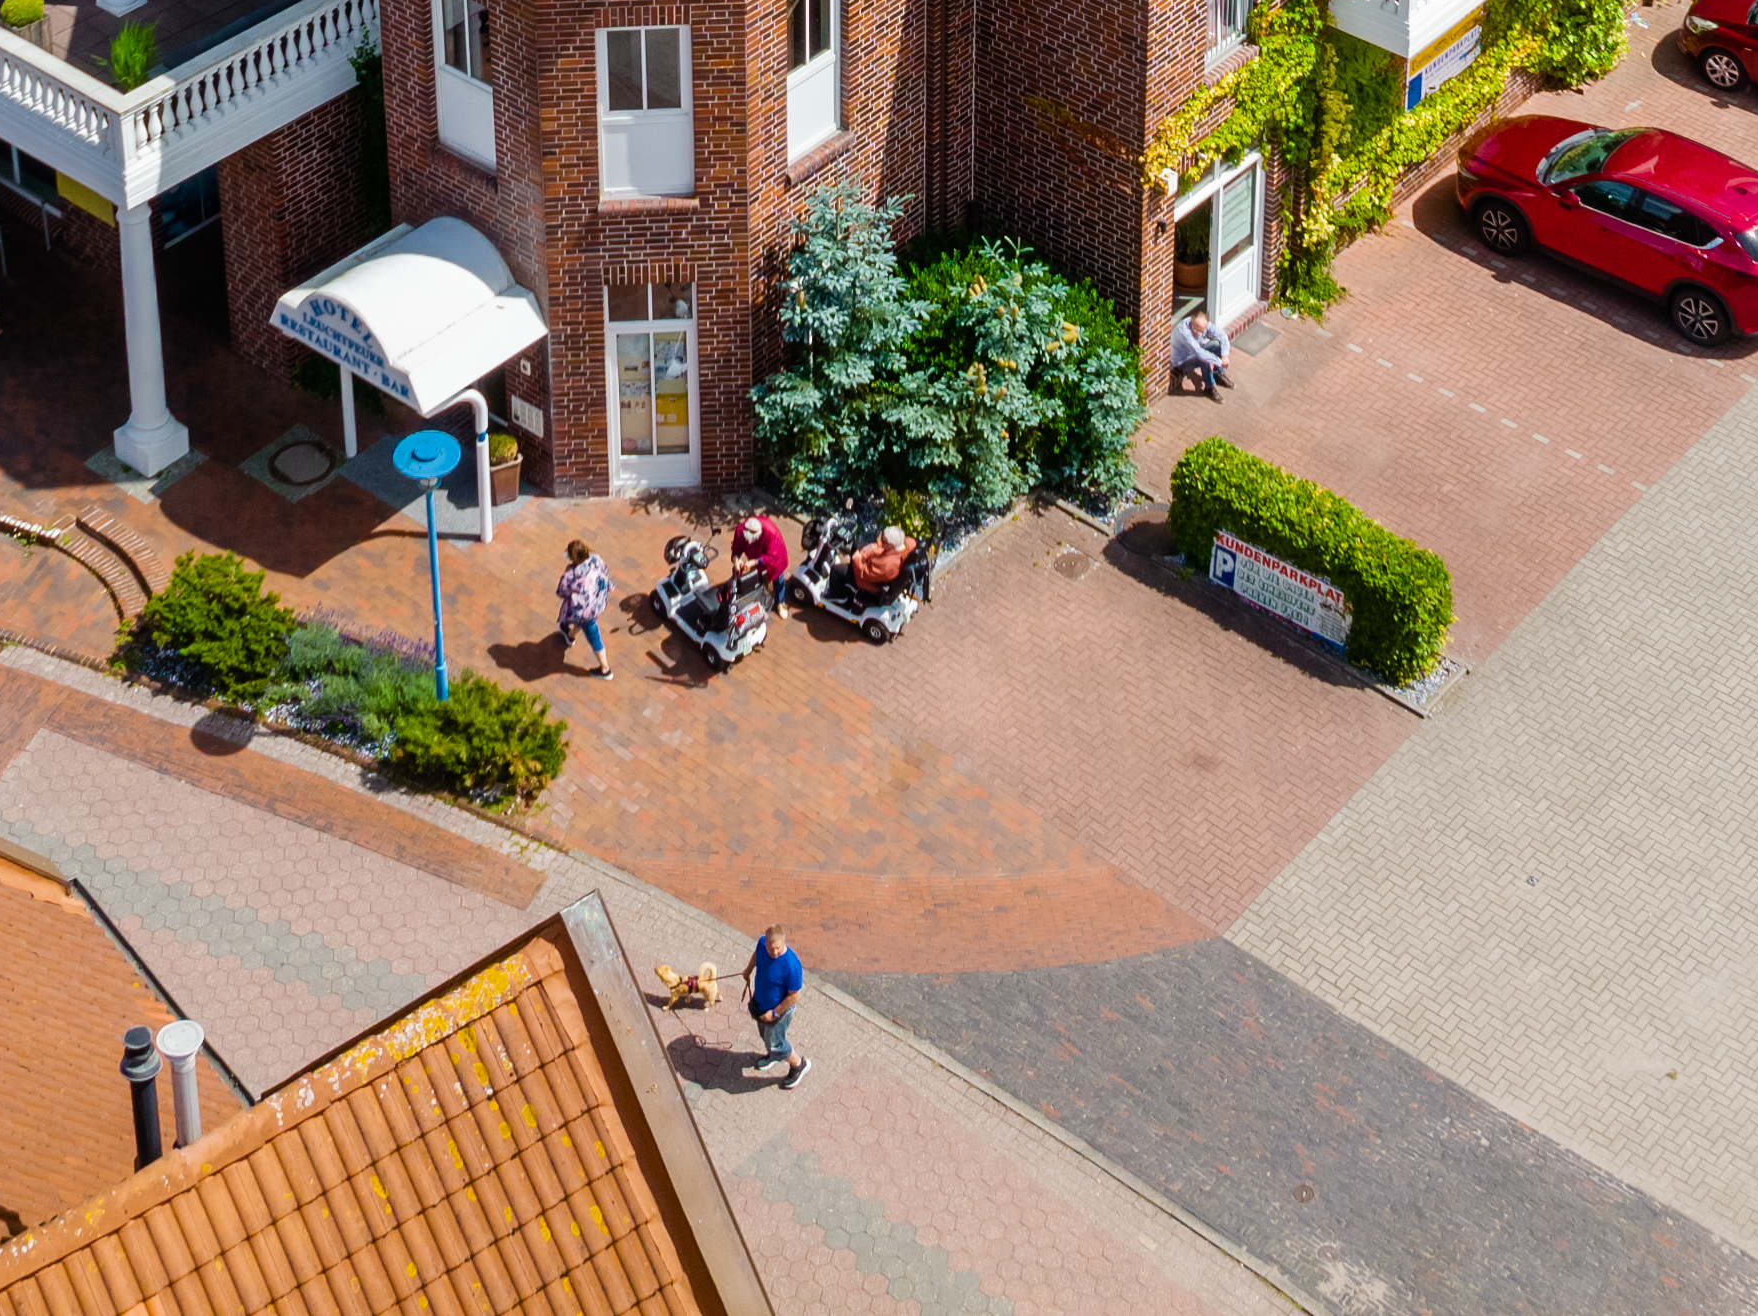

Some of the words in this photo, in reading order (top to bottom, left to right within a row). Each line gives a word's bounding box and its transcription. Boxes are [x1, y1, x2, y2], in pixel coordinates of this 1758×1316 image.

[308, 298, 374, 349] HOTEL
[280, 313, 370, 375] RESTAURANT
[381, 372, 411, 399] BAR
[1214, 548, 1236, 579] P
[1216, 532, 1345, 603] KUNDENPARKPLAT
